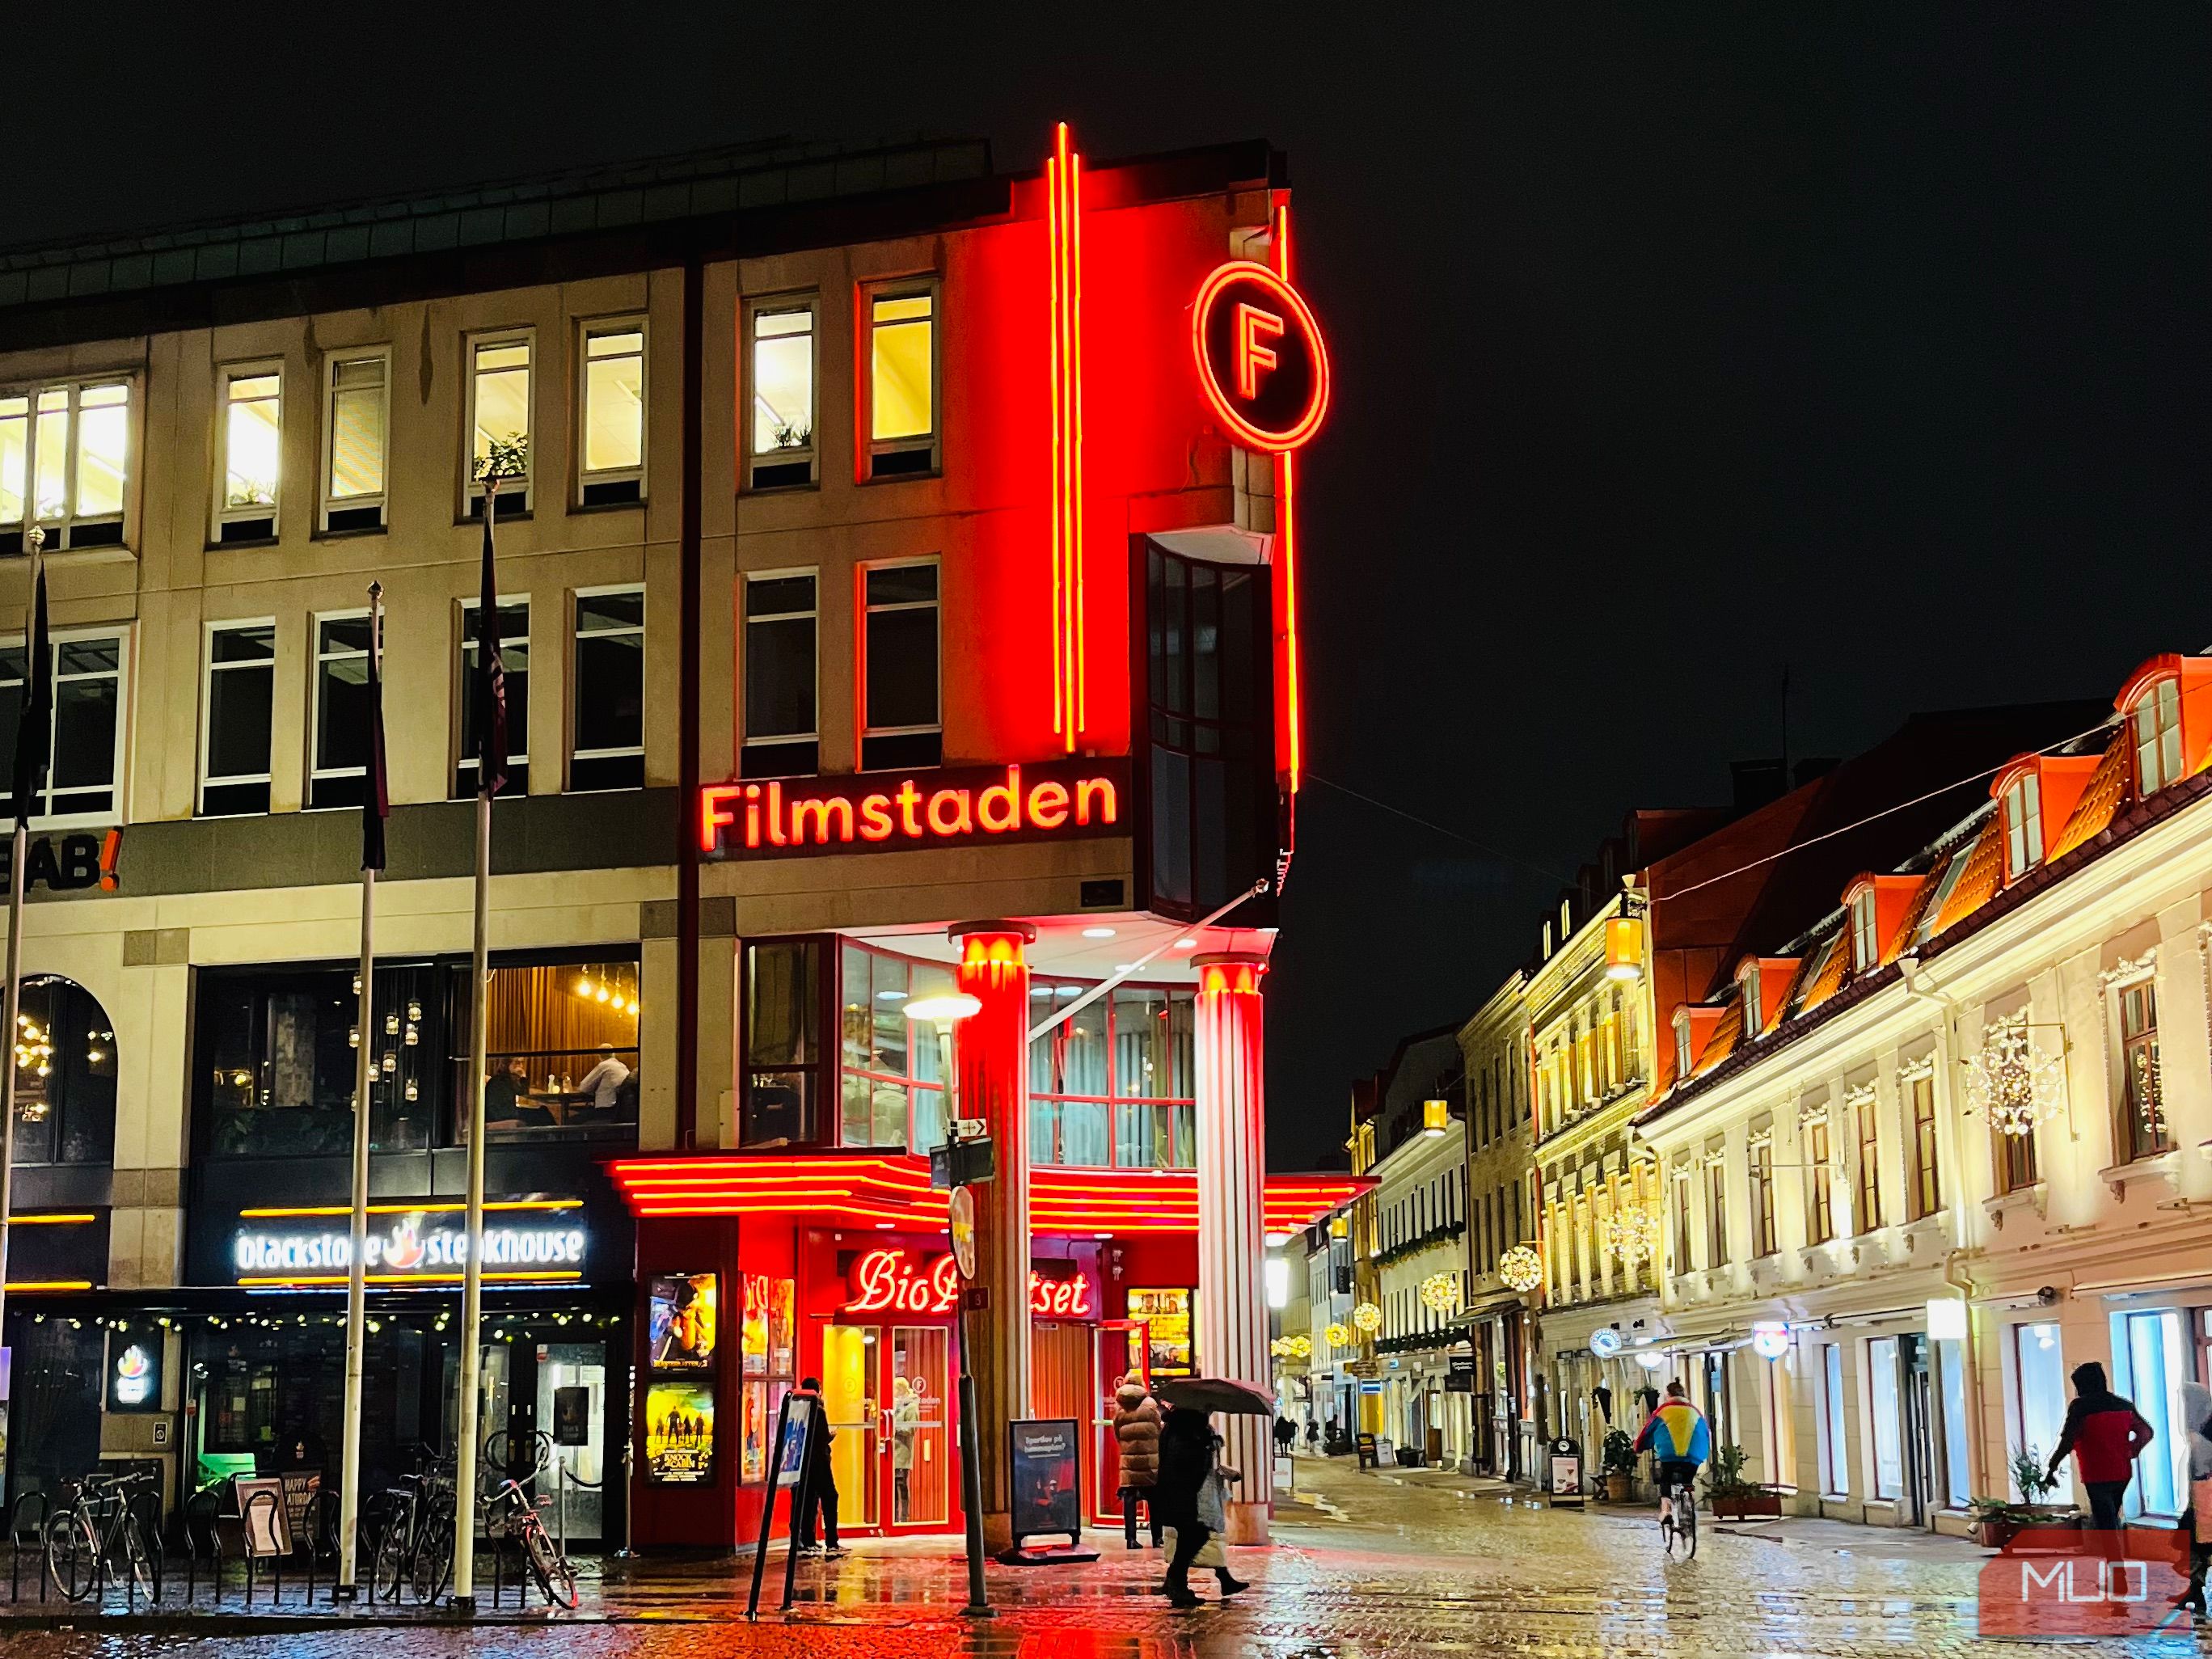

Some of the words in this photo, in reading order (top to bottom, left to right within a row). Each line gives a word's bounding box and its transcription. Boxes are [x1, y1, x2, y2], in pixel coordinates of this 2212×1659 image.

[1239, 302, 1285, 400] F
[700, 764, 1117, 851] Filmstaden
[237, 1235, 381, 1269] blackstoe
[427, 1229, 584, 1264] stekhouse
[285, 1477, 307, 1492] HAPPY
